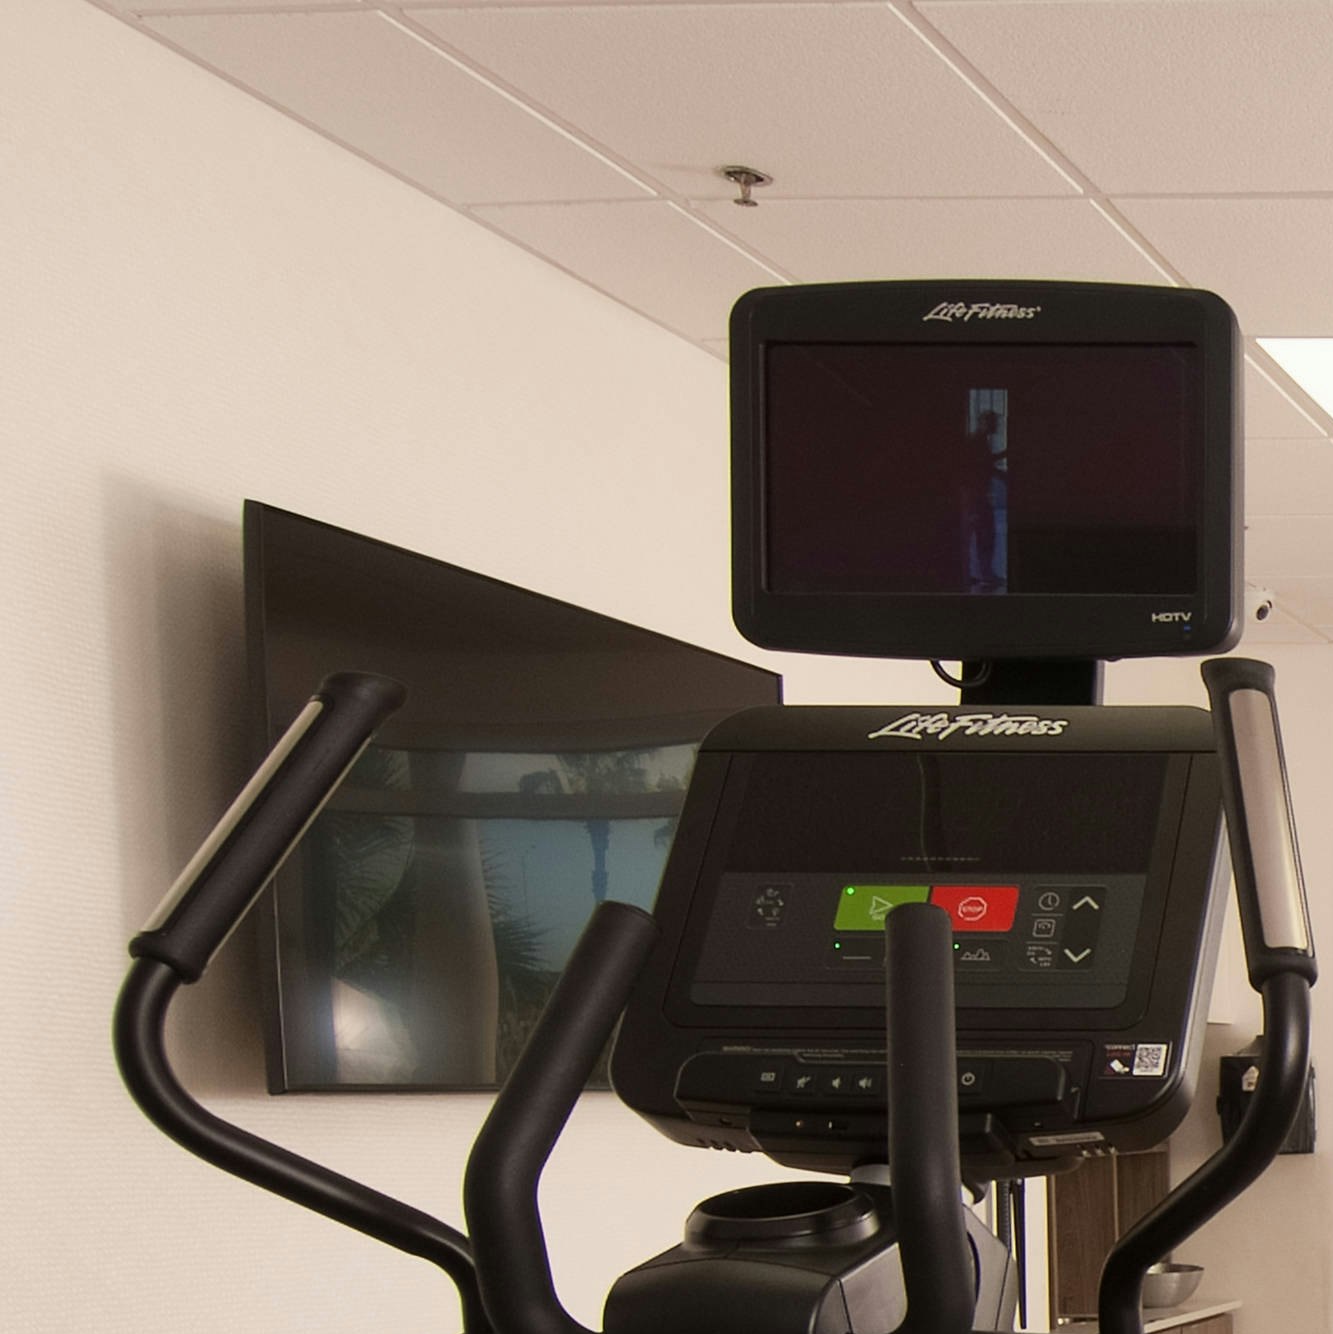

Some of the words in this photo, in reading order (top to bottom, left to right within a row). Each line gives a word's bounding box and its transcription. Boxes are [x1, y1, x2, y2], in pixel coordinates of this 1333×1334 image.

[963, 302, 1036, 322] Fitness
[1151, 611, 1192, 622] HDTV
[868, 713, 949, 740] Life
[938, 713, 1068, 741] Fitness
